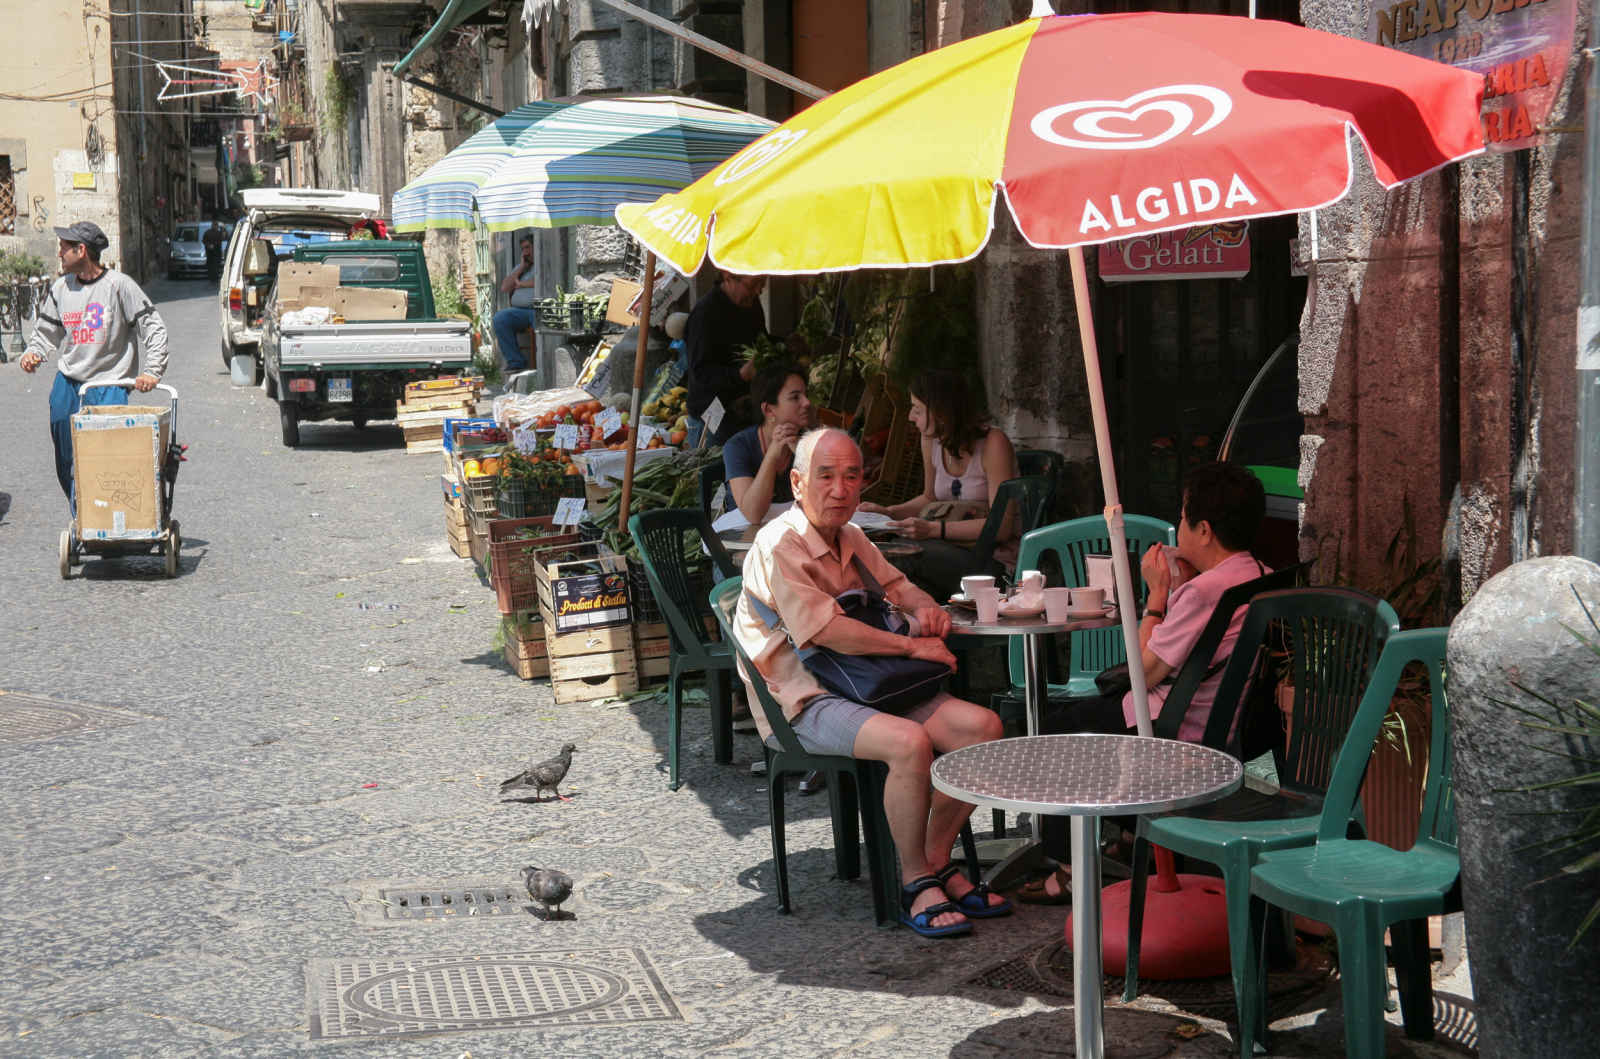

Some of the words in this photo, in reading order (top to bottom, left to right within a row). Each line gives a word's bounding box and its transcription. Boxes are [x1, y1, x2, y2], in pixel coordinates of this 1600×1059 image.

[1376, 0, 1548, 47] NEAPO
[1431, 31, 1482, 65] 1920
[1079, 173, 1258, 234] ALGIDA
[1123, 237, 1224, 271] Gelati
[86, 303, 104, 330] 3
[289, 348, 305, 356] Ape
[428, 345, 443, 353] Top
[444, 344, 465, 352] Deck
[558, 597, 593, 616] Prodotti
[594, 594, 603, 609] di
[602, 591, 627, 608] Sicilia
